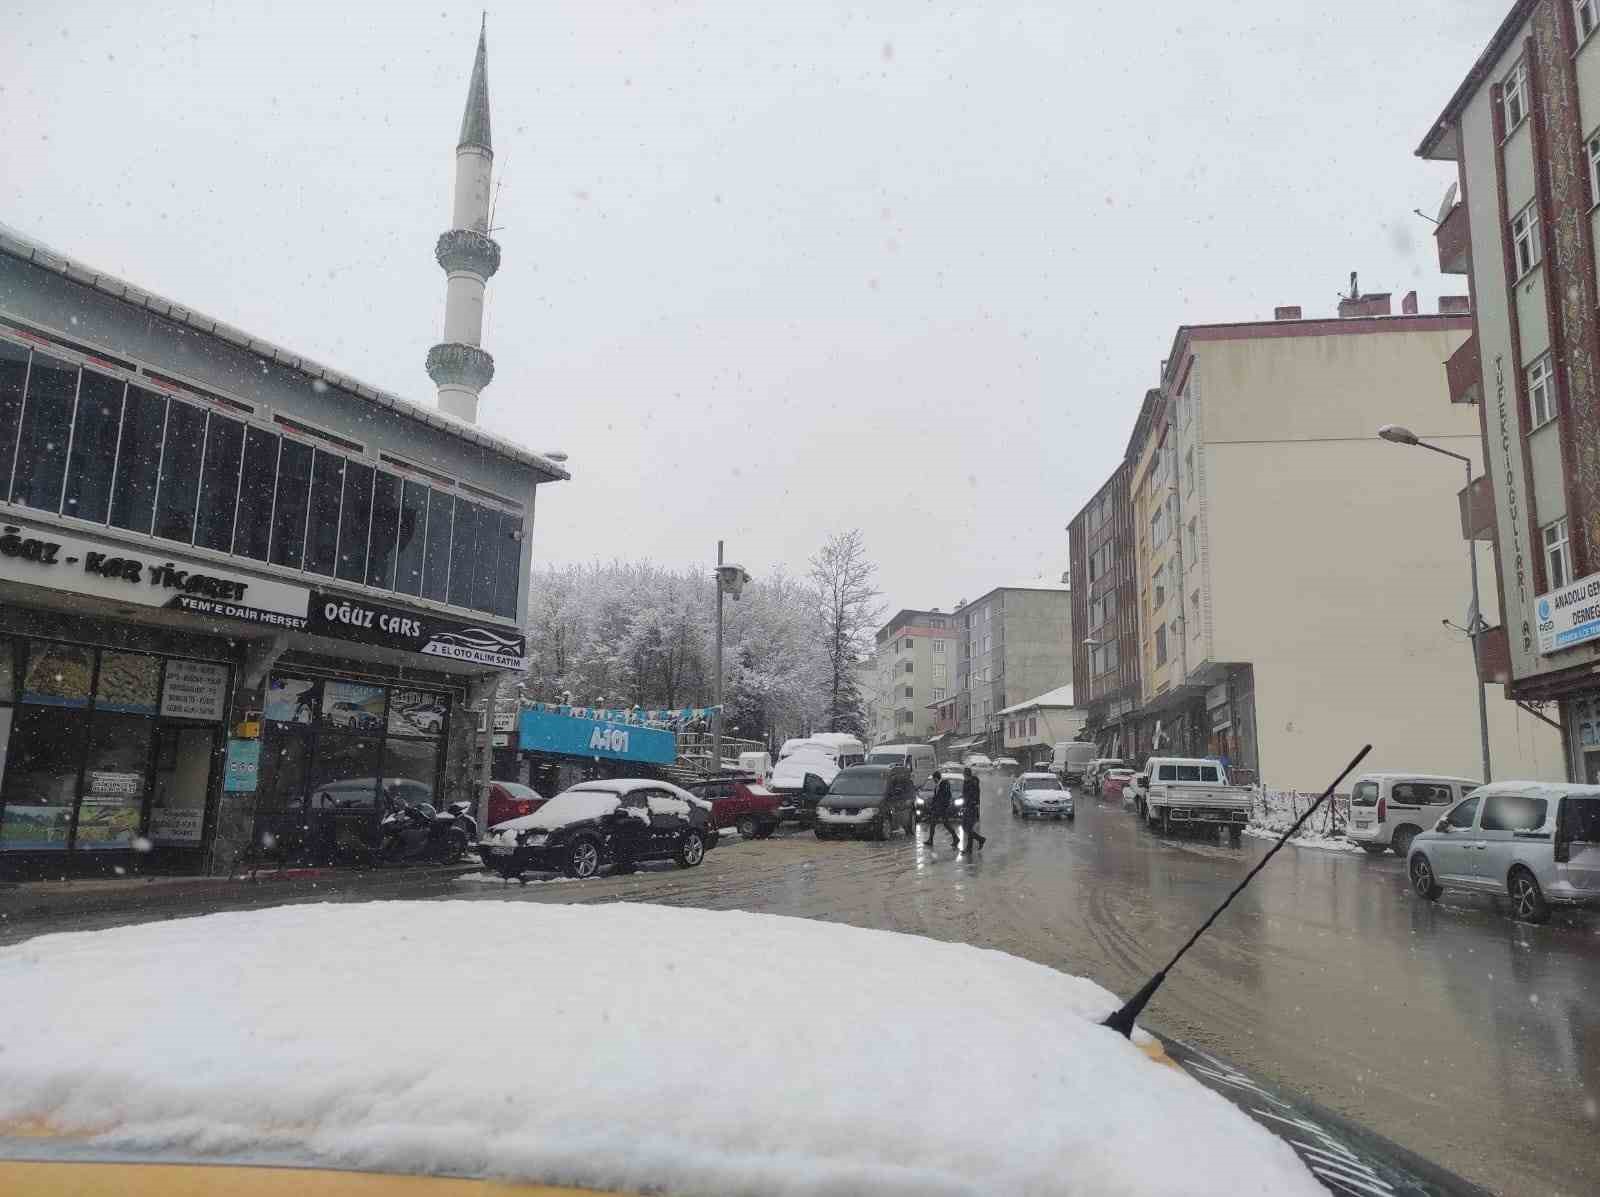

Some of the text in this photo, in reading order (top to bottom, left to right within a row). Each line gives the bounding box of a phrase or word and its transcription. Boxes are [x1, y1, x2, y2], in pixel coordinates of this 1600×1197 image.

[85, 551, 142, 583] KAR
[1555, 586, 1586, 609] ANADOLU
[325, 601, 421, 636] OĞUZ CARS
[442, 645, 451, 655] EL
[454, 648, 472, 658] OTO
